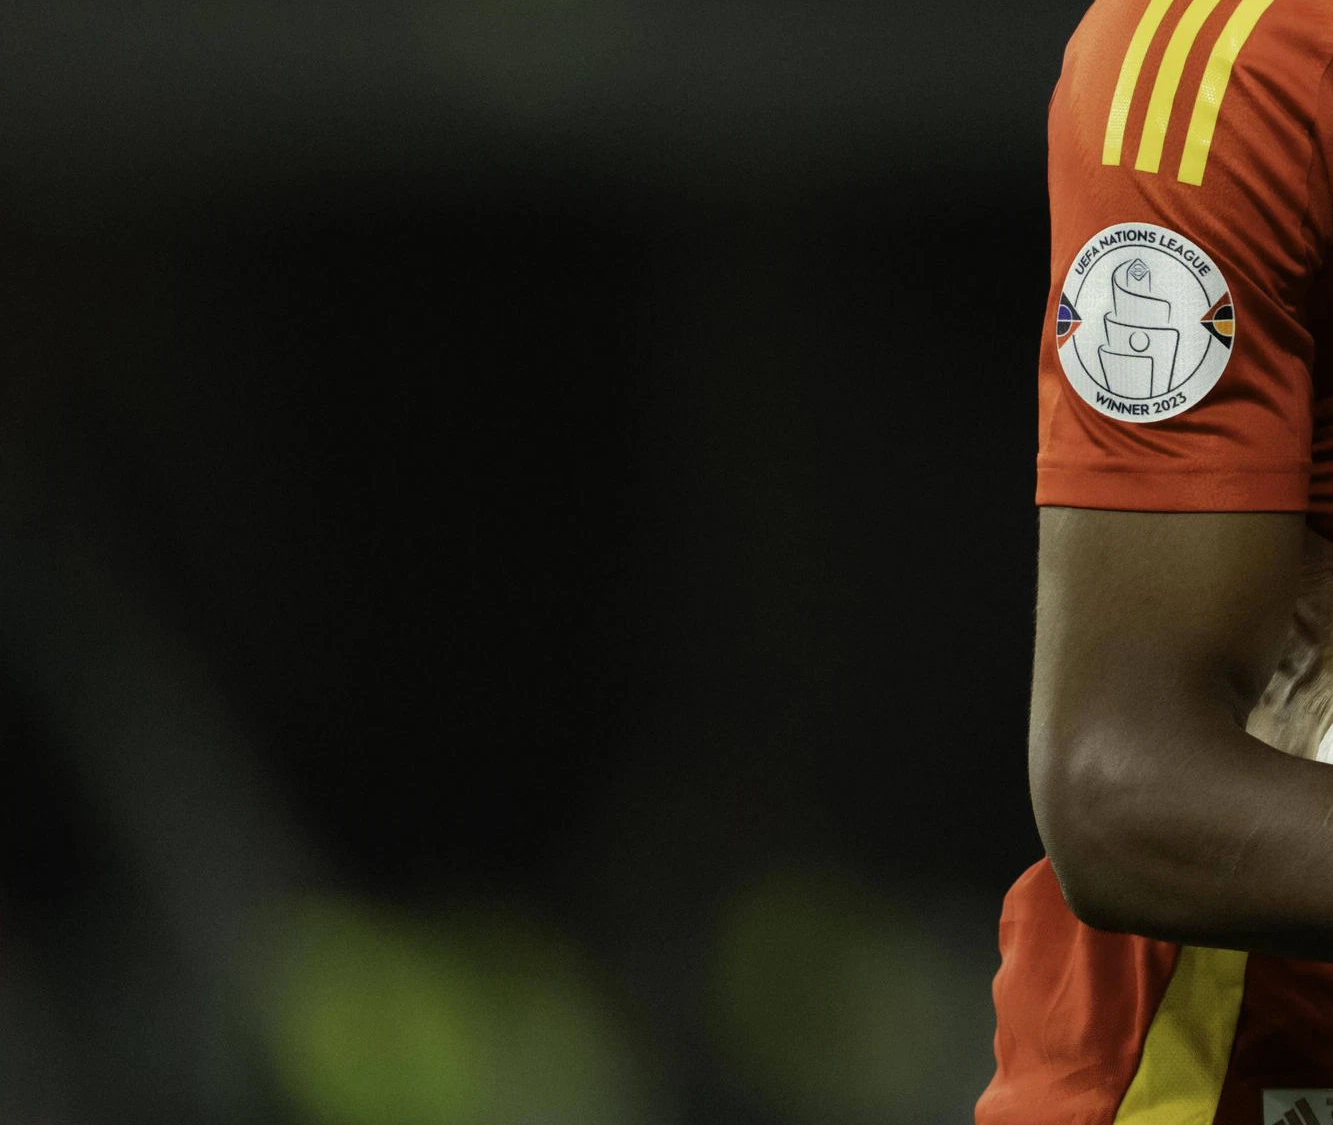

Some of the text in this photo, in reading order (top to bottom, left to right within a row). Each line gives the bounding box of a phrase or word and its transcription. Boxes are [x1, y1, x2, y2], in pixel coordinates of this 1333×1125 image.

[1075, 229, 1211, 277] UEFA NATIONS LEAGUE
[1095, 391, 1187, 416] WINNER 2023
